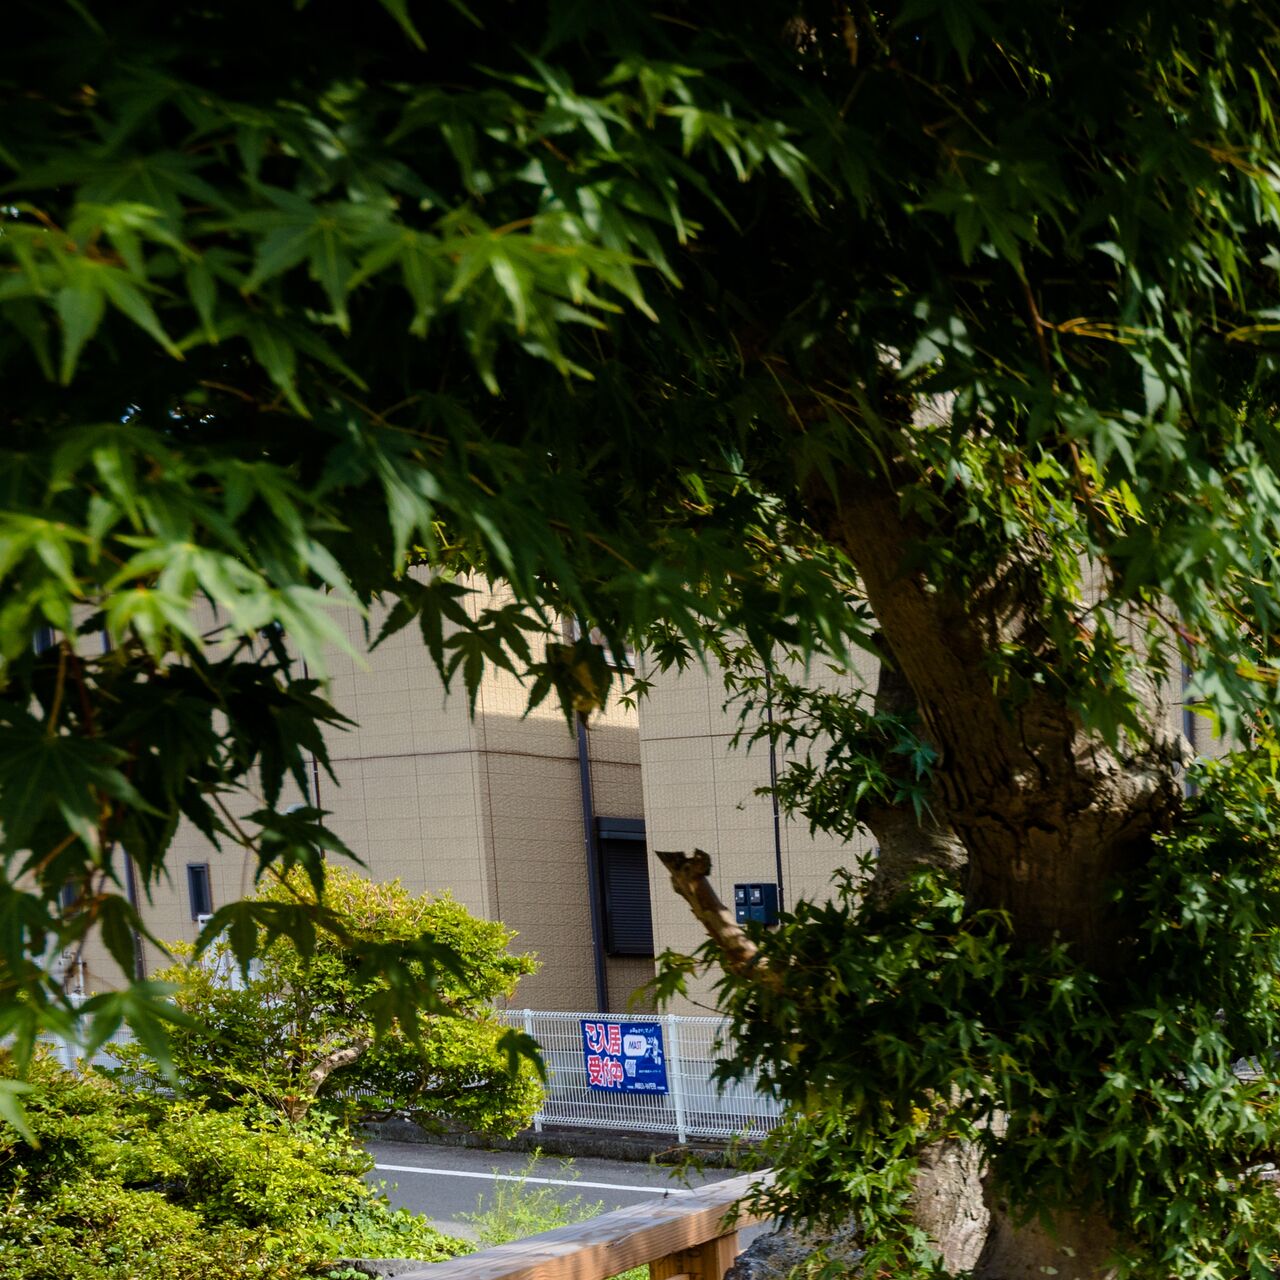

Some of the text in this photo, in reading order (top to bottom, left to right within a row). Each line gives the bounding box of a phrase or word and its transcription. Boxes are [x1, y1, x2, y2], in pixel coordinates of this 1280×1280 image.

[628, 1041, 642, 1050] MAST
[587, 1055, 624, 1088] 受付中
